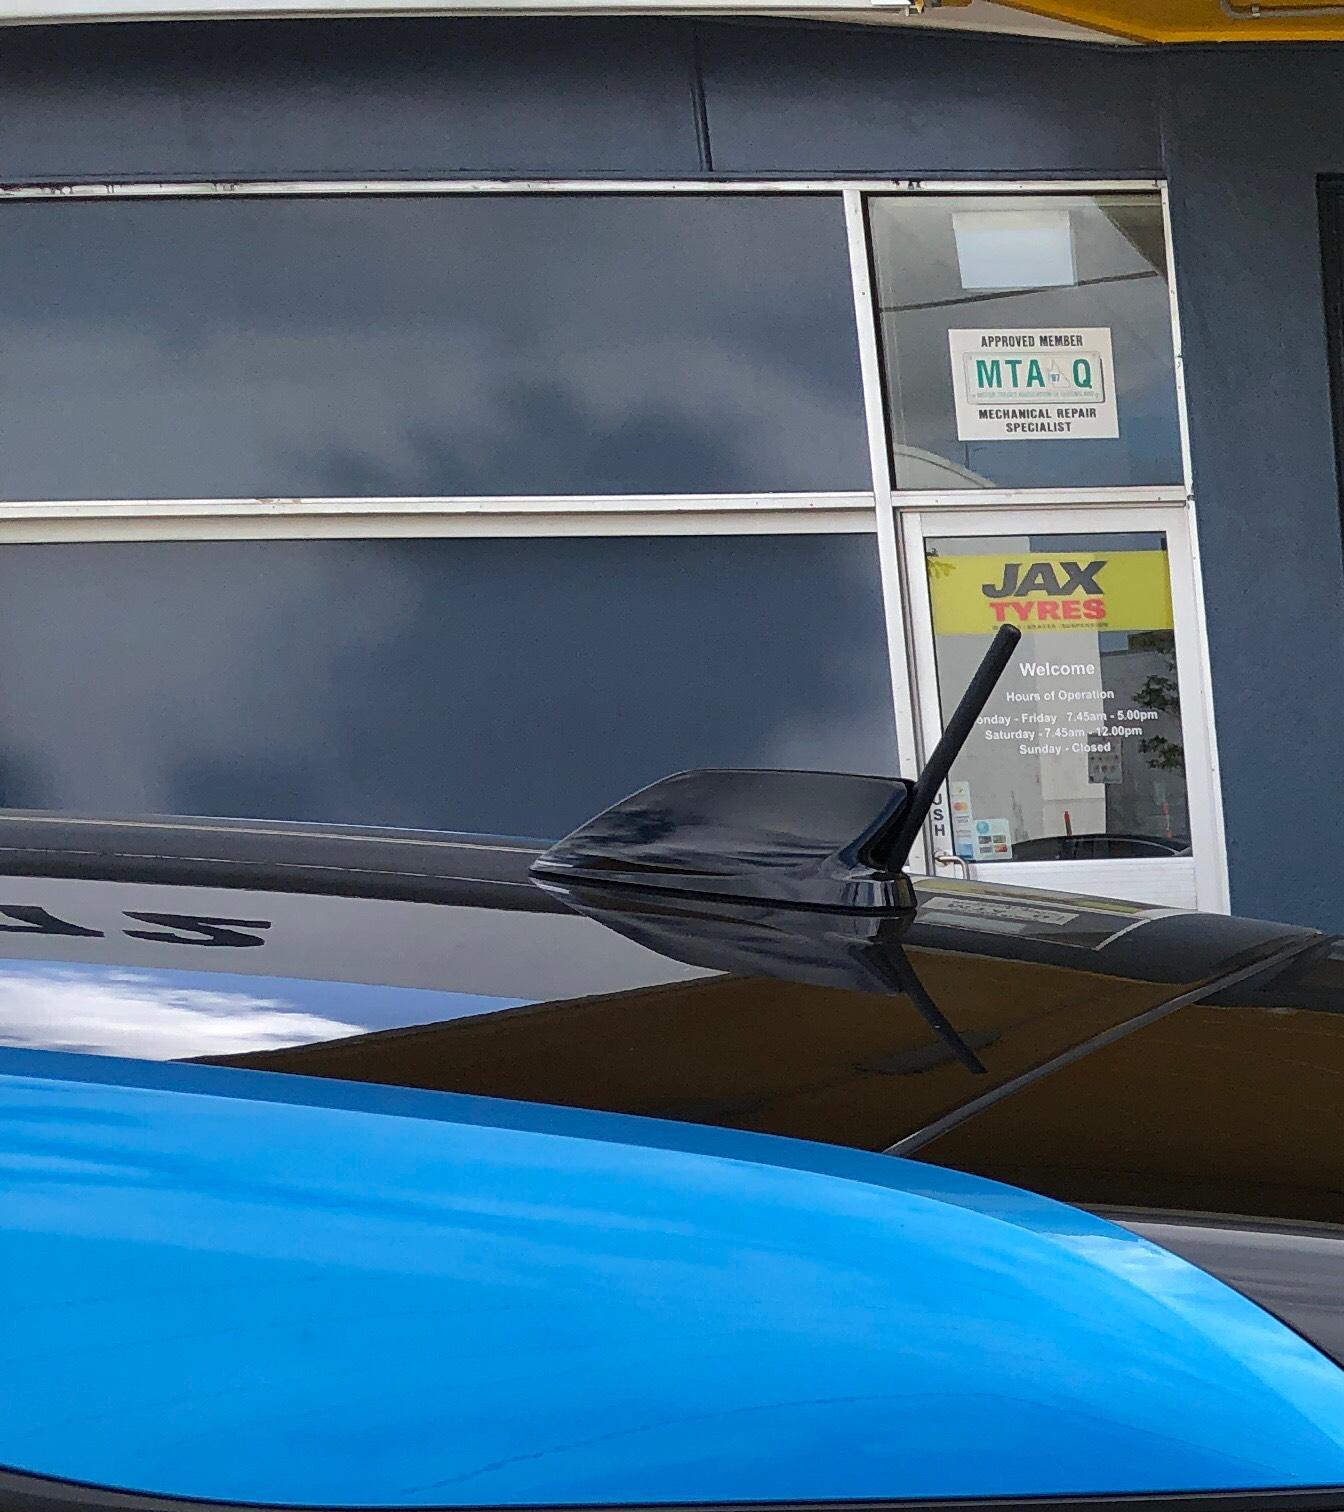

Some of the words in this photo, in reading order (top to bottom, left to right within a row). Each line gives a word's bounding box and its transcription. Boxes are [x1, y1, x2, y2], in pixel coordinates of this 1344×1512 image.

[981, 335, 1035, 347] APPROVED
[1039, 334, 1083, 347] MEMBER
[975, 358, 1046, 388] MTA
[1072, 358, 1093, 389] Q
[978, 408, 1052, 420] MECHANICAL
[1057, 407, 1097, 419] REPAIR
[1005, 421, 1072, 433] SPECIALIST
[981, 560, 1108, 598] JAX
[988, 598, 1107, 622] TYRES
[1019, 662, 1096, 677] Welcome
[1006, 691, 1041, 702] Hours
[1044, 690, 1055, 701] of
[1058, 689, 1115, 702] Operation
[976, 714, 1011, 727] onday
[1021, 712, 1057, 725] Friday
[1066, 711, 1107, 723] 7.45am
[1117, 710, 1159, 723] 5.00pm
[985, 728, 1035, 742] Saturday
[1096, 725, 1143, 738] 12.00pm
[1019, 743, 1062, 756] Sunday
[1071, 741, 1111, 753] Closed
